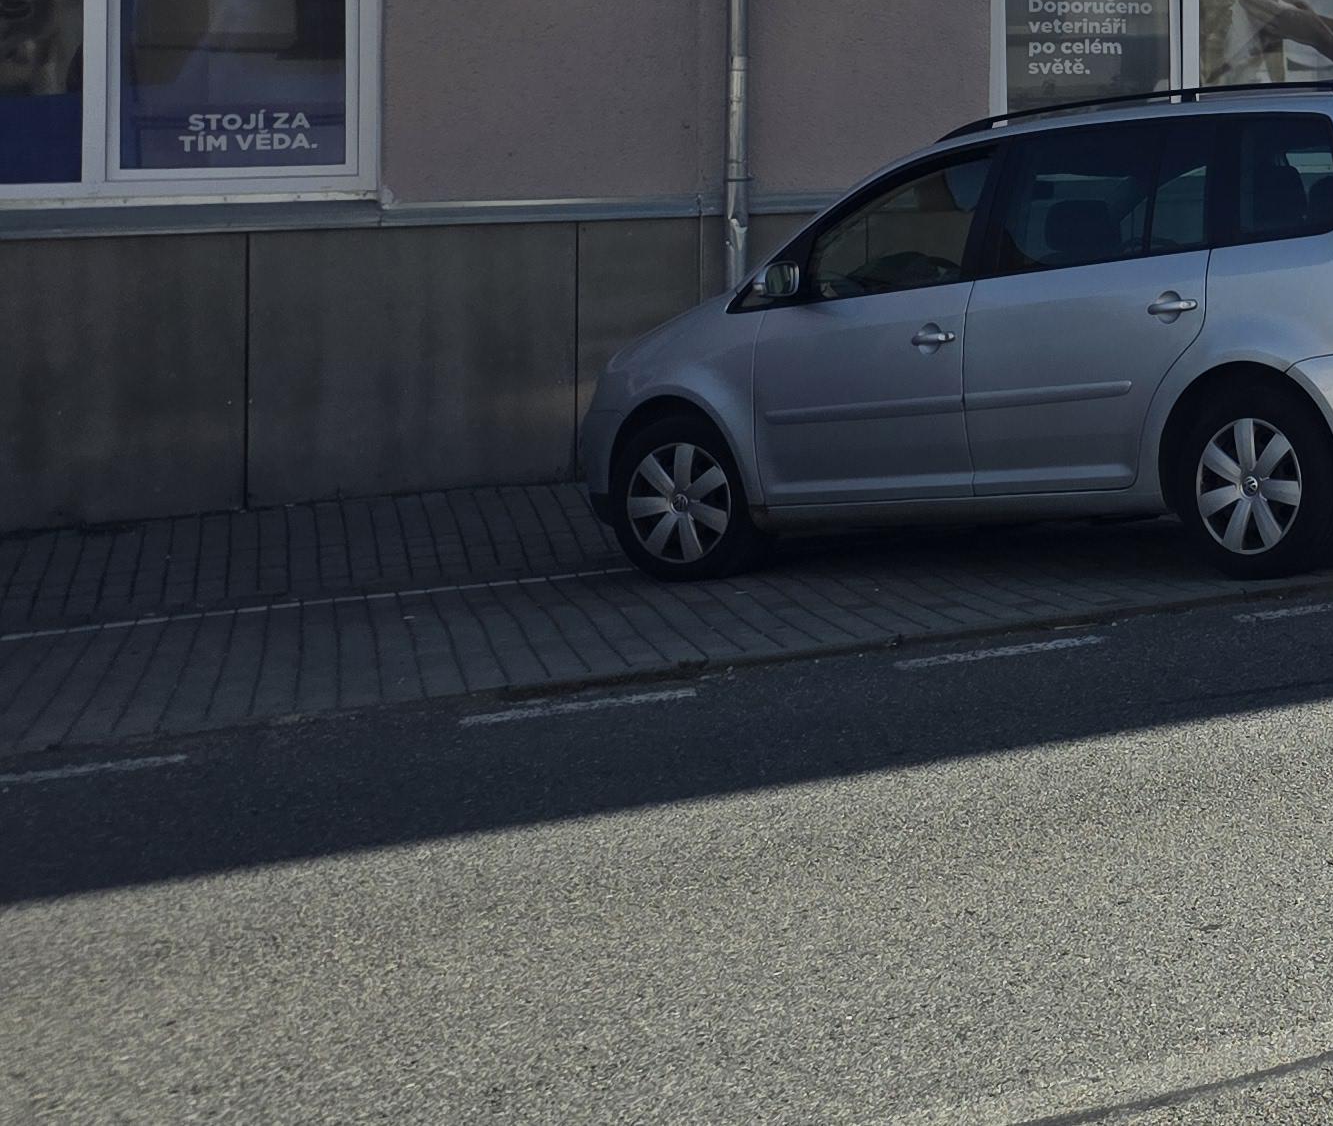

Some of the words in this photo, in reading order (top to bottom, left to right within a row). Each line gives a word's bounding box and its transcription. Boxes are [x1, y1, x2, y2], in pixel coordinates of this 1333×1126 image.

[1028, 16, 1127, 35] veterináři
[1028, 41, 1055, 58] po
[1060, 36, 1123, 56] celém
[1028, 57, 1091, 76] světě.
[188, 109, 267, 132] STOJÍ
[273, 112, 310, 129] ZA
[178, 130, 228, 153] TÍM
[235, 129, 318, 151] VĚDA.
